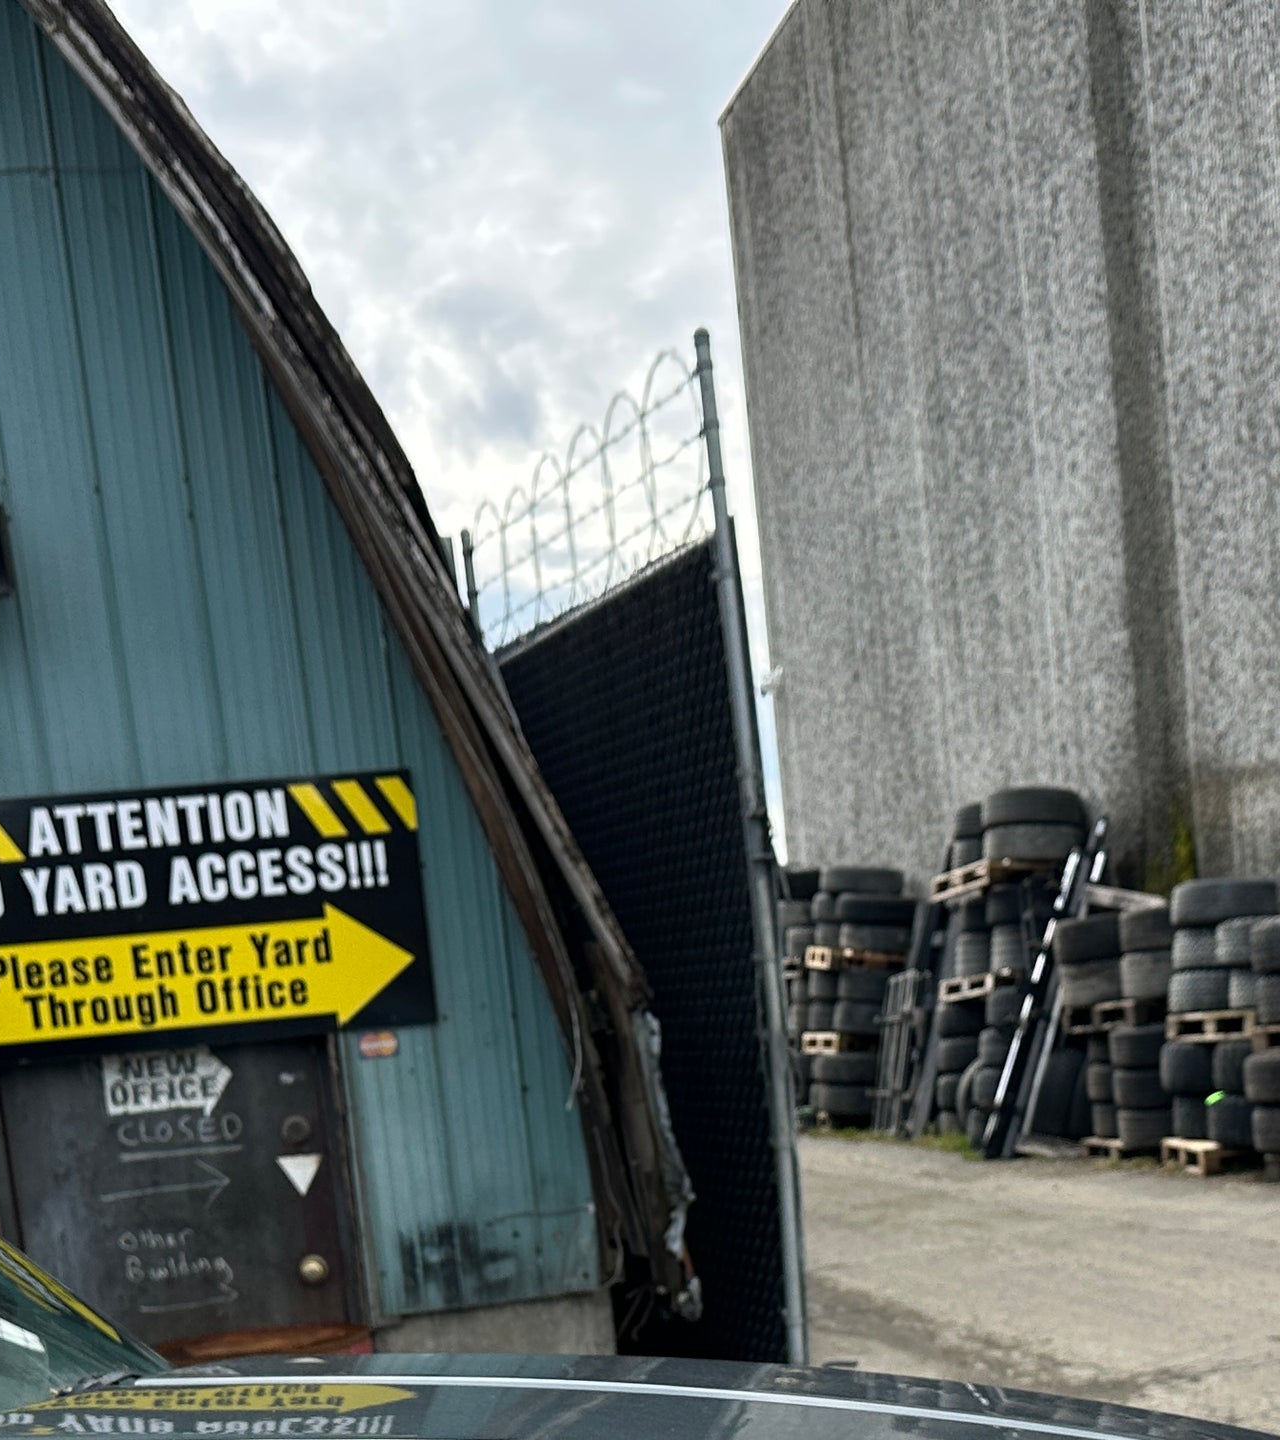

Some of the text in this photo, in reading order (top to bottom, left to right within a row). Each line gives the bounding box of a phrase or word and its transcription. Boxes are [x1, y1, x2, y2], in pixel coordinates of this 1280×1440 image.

[27, 788, 291, 858] ATTENTION
[20, 859, 148, 917] YARD
[168, 840, 390, 905] ACCESS!!!
[131, 940, 233, 978] Enter
[249, 928, 333, 967] Yard
[23, 973, 310, 1031] Through Office
[110, 1073, 220, 1107] OFFICE
[123, 1051, 197, 1080] NEW
[117, 1111, 243, 1147] CLOSED
